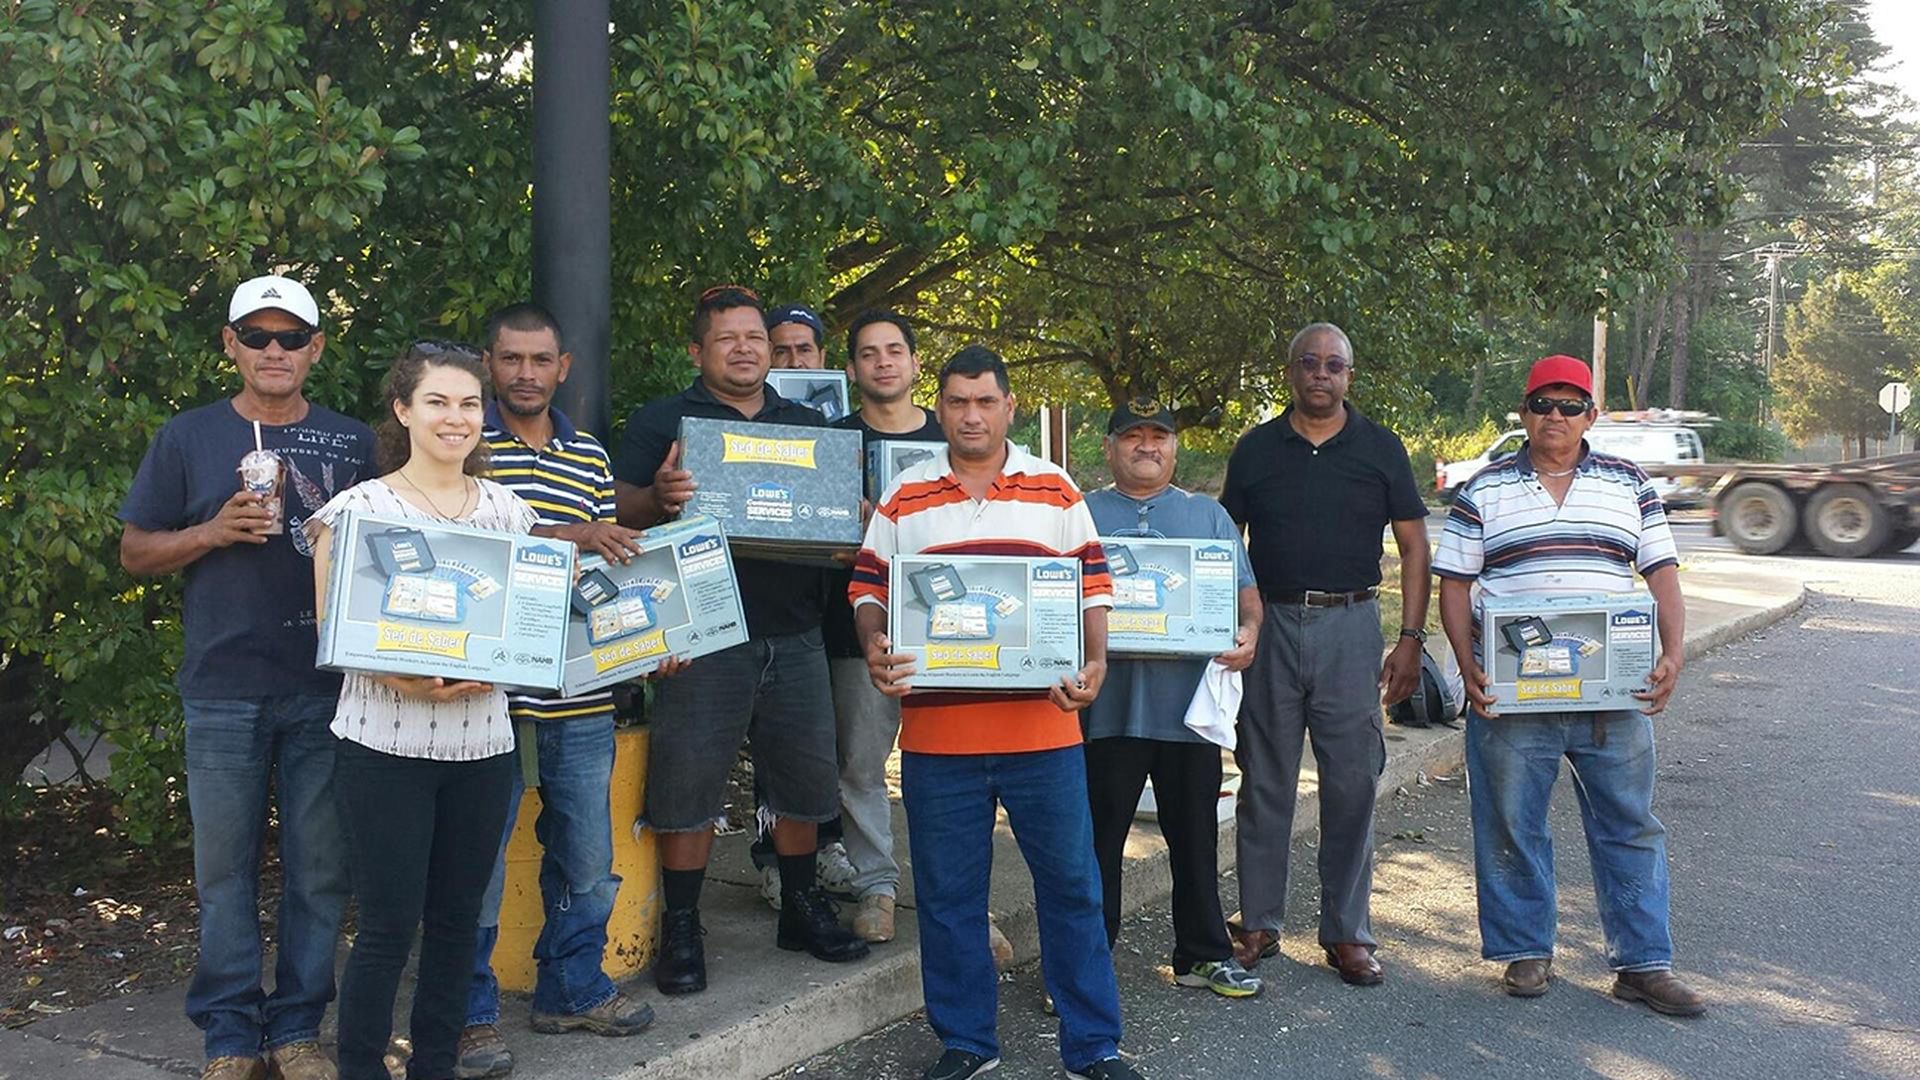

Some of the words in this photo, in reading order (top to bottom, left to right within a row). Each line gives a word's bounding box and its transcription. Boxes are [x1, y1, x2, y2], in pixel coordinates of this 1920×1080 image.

[272, 447, 320, 456] OUNDED
[731, 440, 753, 453] Sed
[757, 442, 771, 455] de
[775, 441, 807, 457] Saber
[751, 487, 789, 499] LOWE'S
[747, 506, 793, 517] SERVICES
[682, 539, 719, 557] LOWE'S
[521, 550, 563, 566] LOWE'S
[1199, 551, 1230, 561] LOWE'S
[1036, 568, 1073, 580] LOWE'S
[1615, 615, 1648, 625] LOWE'S
[384, 626, 406, 641] Sed
[410, 629, 424, 644] de
[427, 631, 460, 648] Saber
[598, 650, 618, 664] Sed
[620, 645, 632, 657] de
[633, 637, 661, 653] Saber
